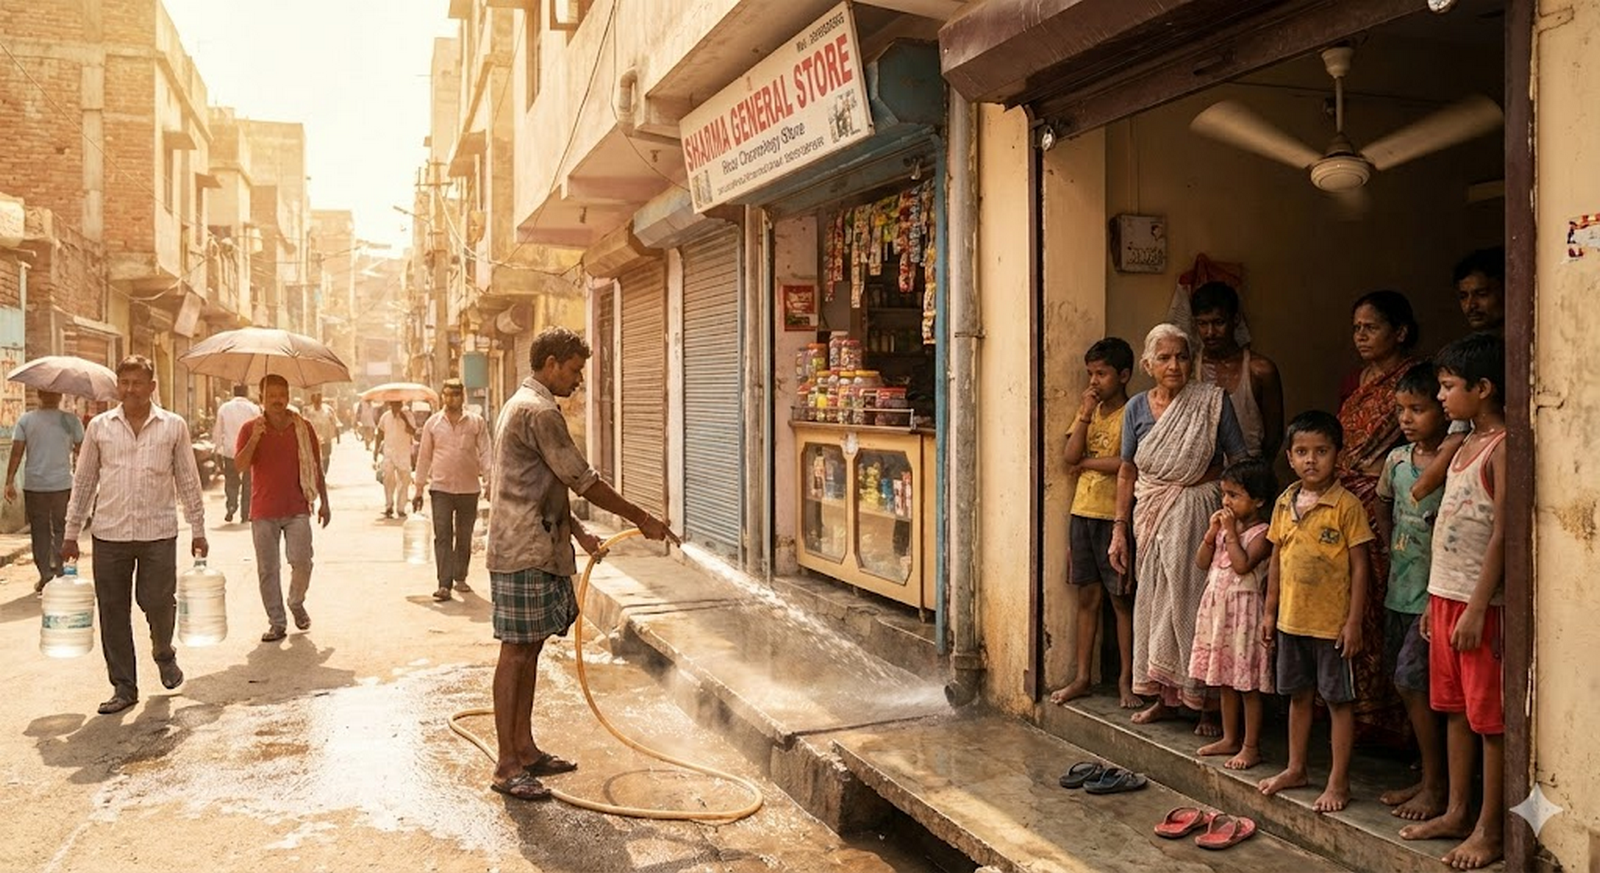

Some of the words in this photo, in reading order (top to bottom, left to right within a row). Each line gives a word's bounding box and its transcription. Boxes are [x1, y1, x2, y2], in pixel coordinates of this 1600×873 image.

[684, 115, 732, 172] SHARMA
[730, 74, 794, 146] GENERAL
[793, 33, 853, 109] STORE
